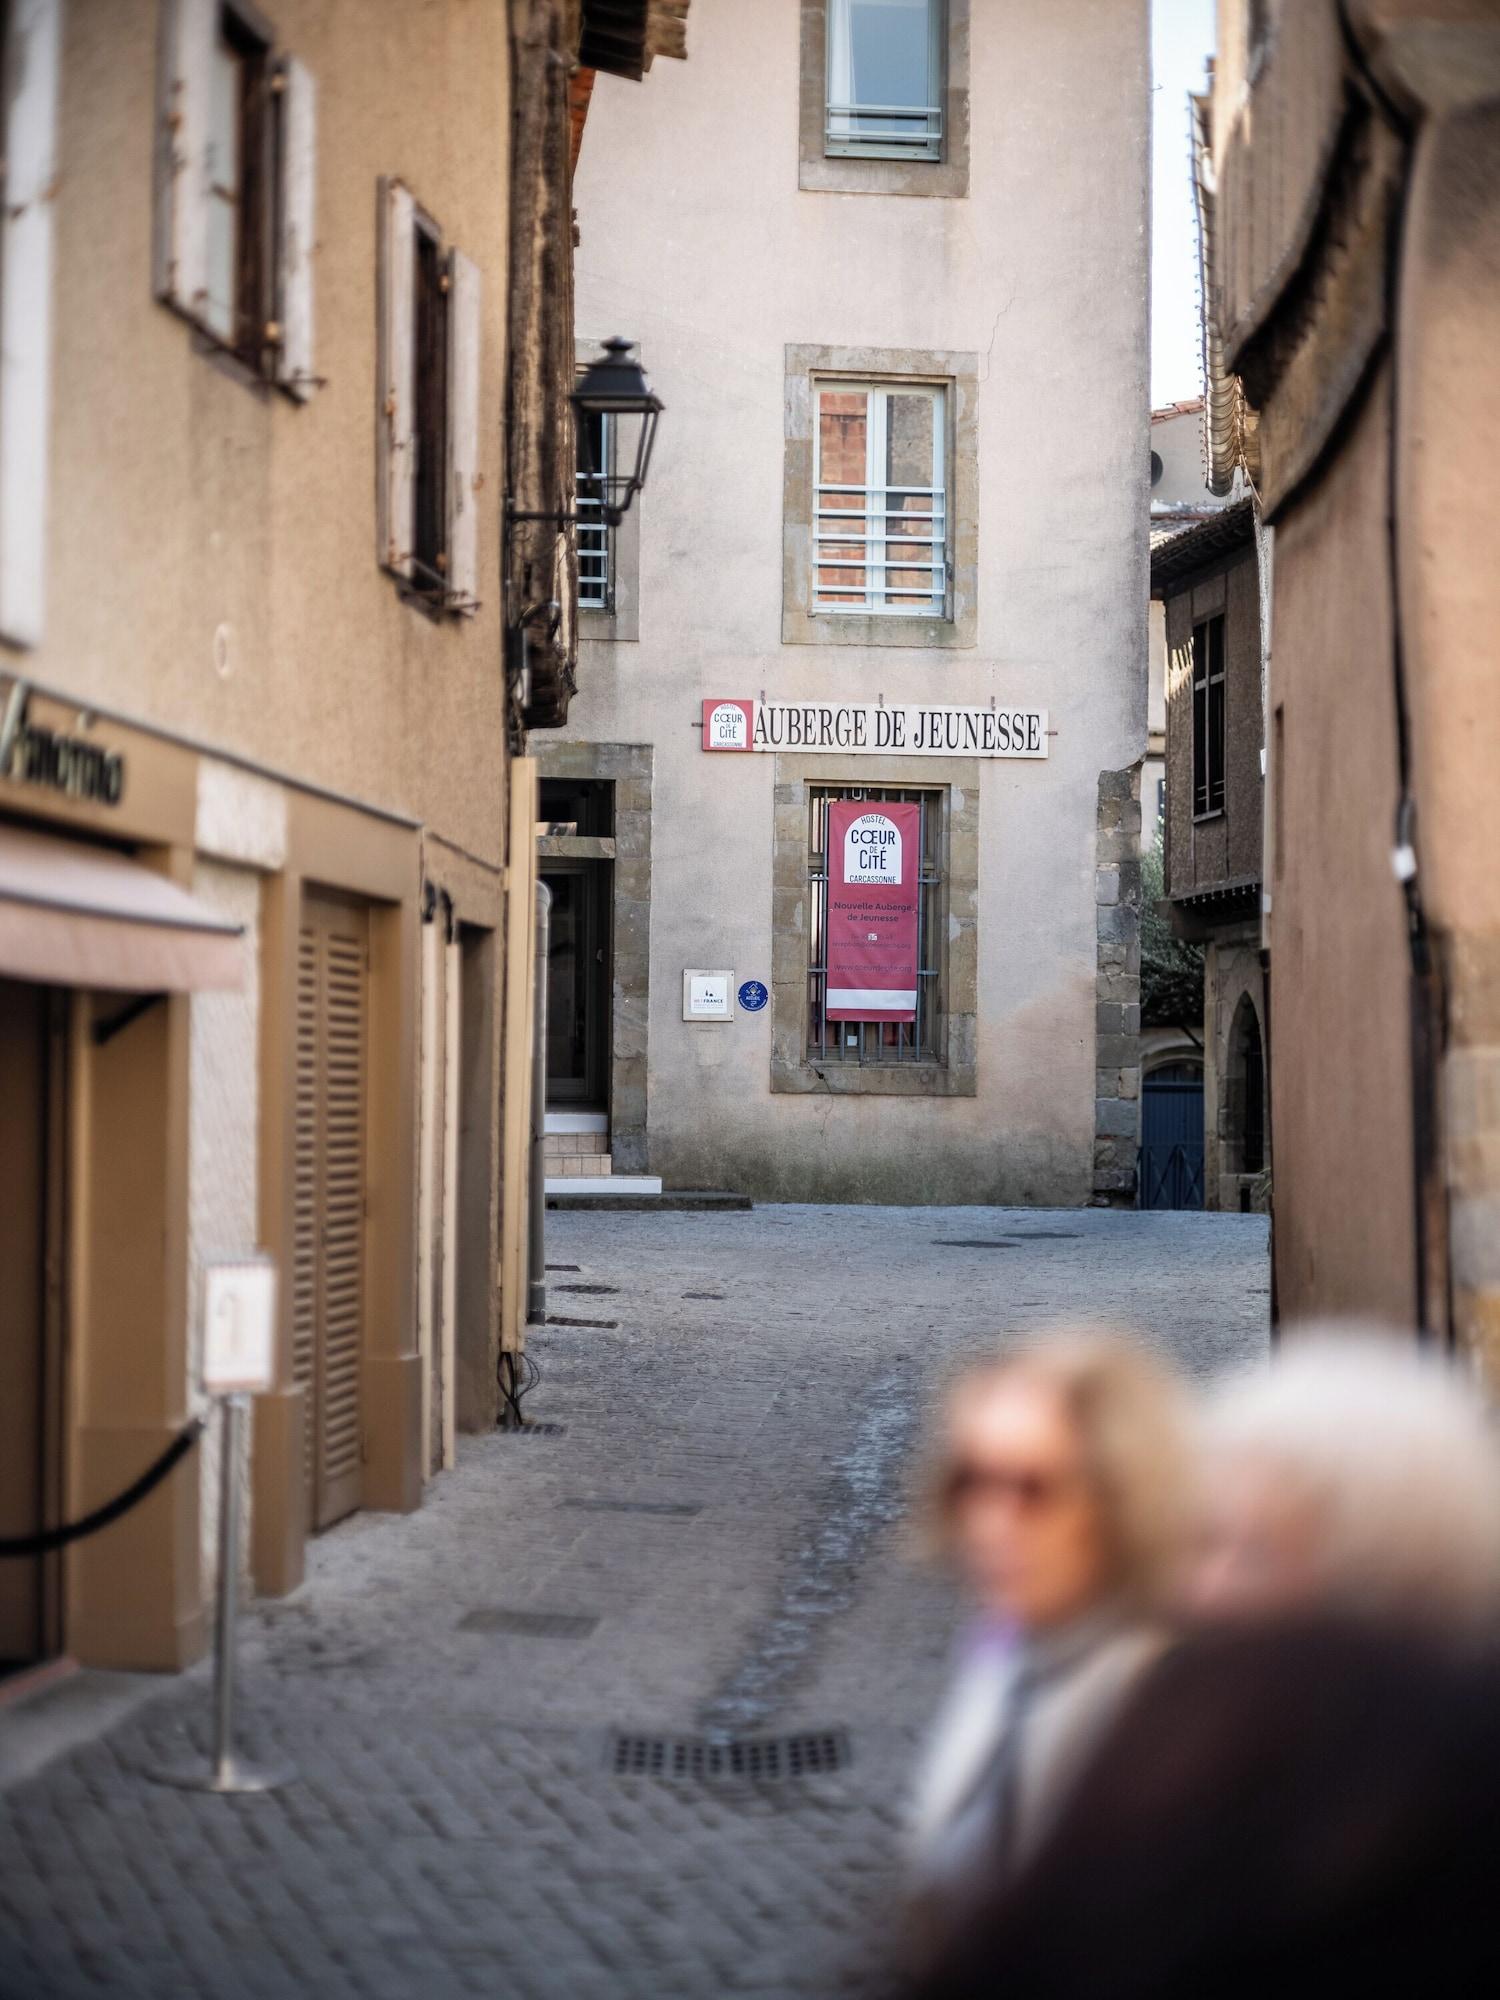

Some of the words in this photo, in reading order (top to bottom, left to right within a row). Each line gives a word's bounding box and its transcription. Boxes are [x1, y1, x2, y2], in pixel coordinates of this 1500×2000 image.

[714, 713, 743, 723] CŒUR
[753, 706, 868, 747] AUBERGE
[875, 710, 906, 748] DE
[913, 712, 1041, 751] JEUNESSE
[860, 815, 886, 825] HOSTEL
[851, 829, 896, 845] CŒUR
[869, 846, 878, 854] DE
[860, 846, 887, 870] CITÉ
[849, 875, 897, 884] CARCASSONNE
[834, 902, 873, 910] Nouvelle
[875, 903, 912, 913] Auberge
[859, 914, 899, 922] Jeunesse
